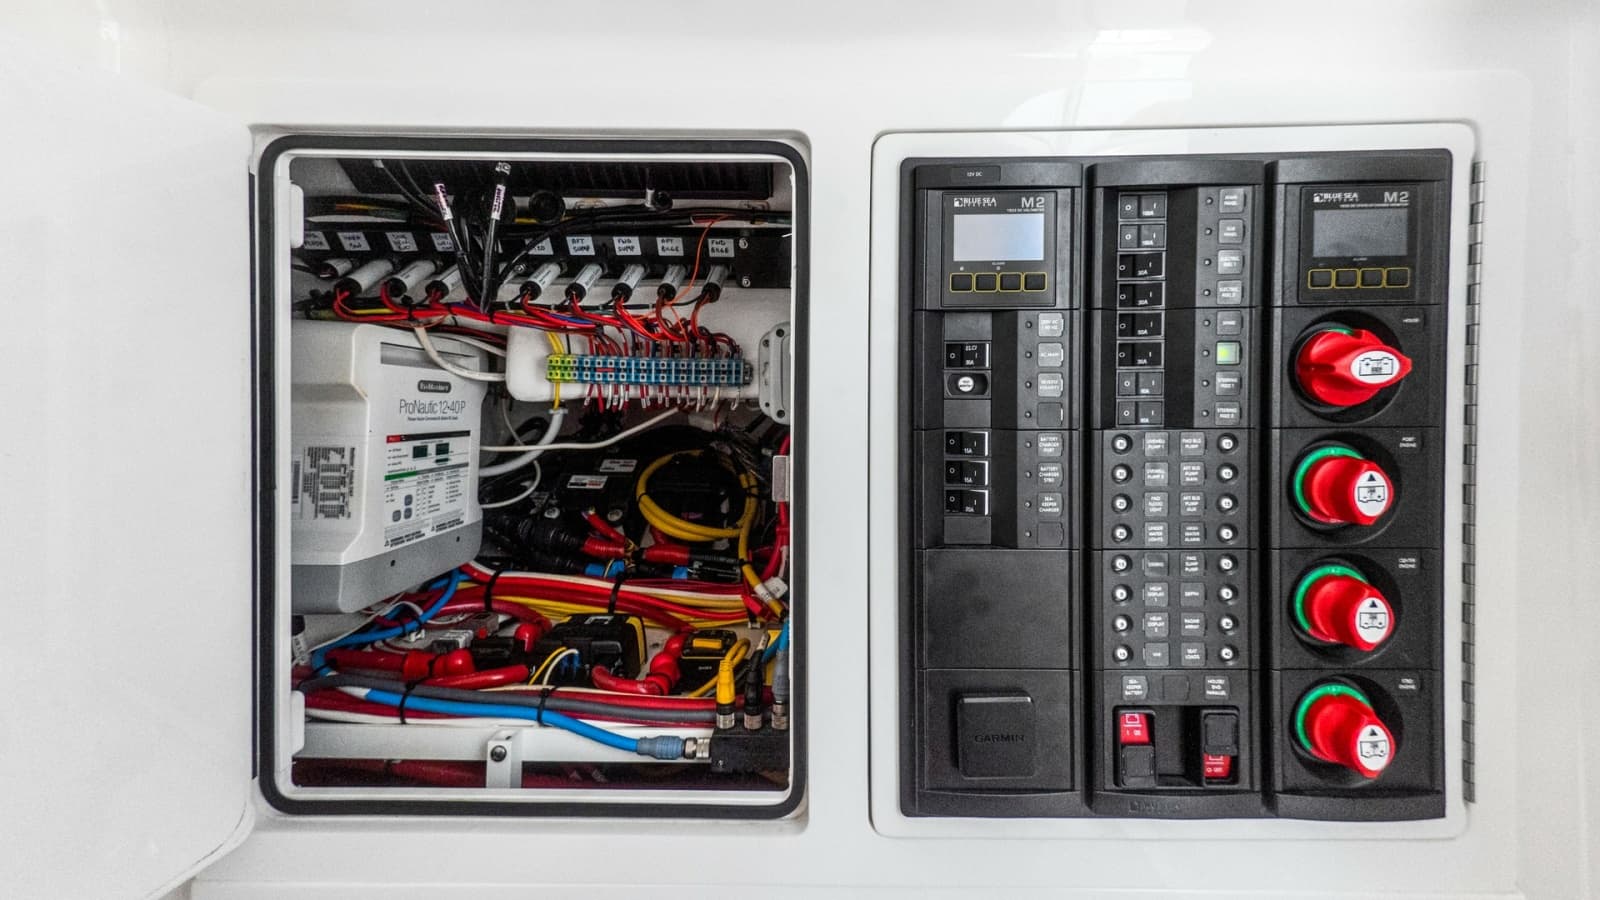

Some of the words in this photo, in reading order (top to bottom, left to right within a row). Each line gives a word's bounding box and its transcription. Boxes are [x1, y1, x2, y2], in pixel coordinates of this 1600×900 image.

[1384, 192, 1409, 202] M2
[1021, 197, 1045, 208] M2
[400, 399, 438, 414] ProNautic
[974, 734, 1024, 742] GARMIN
